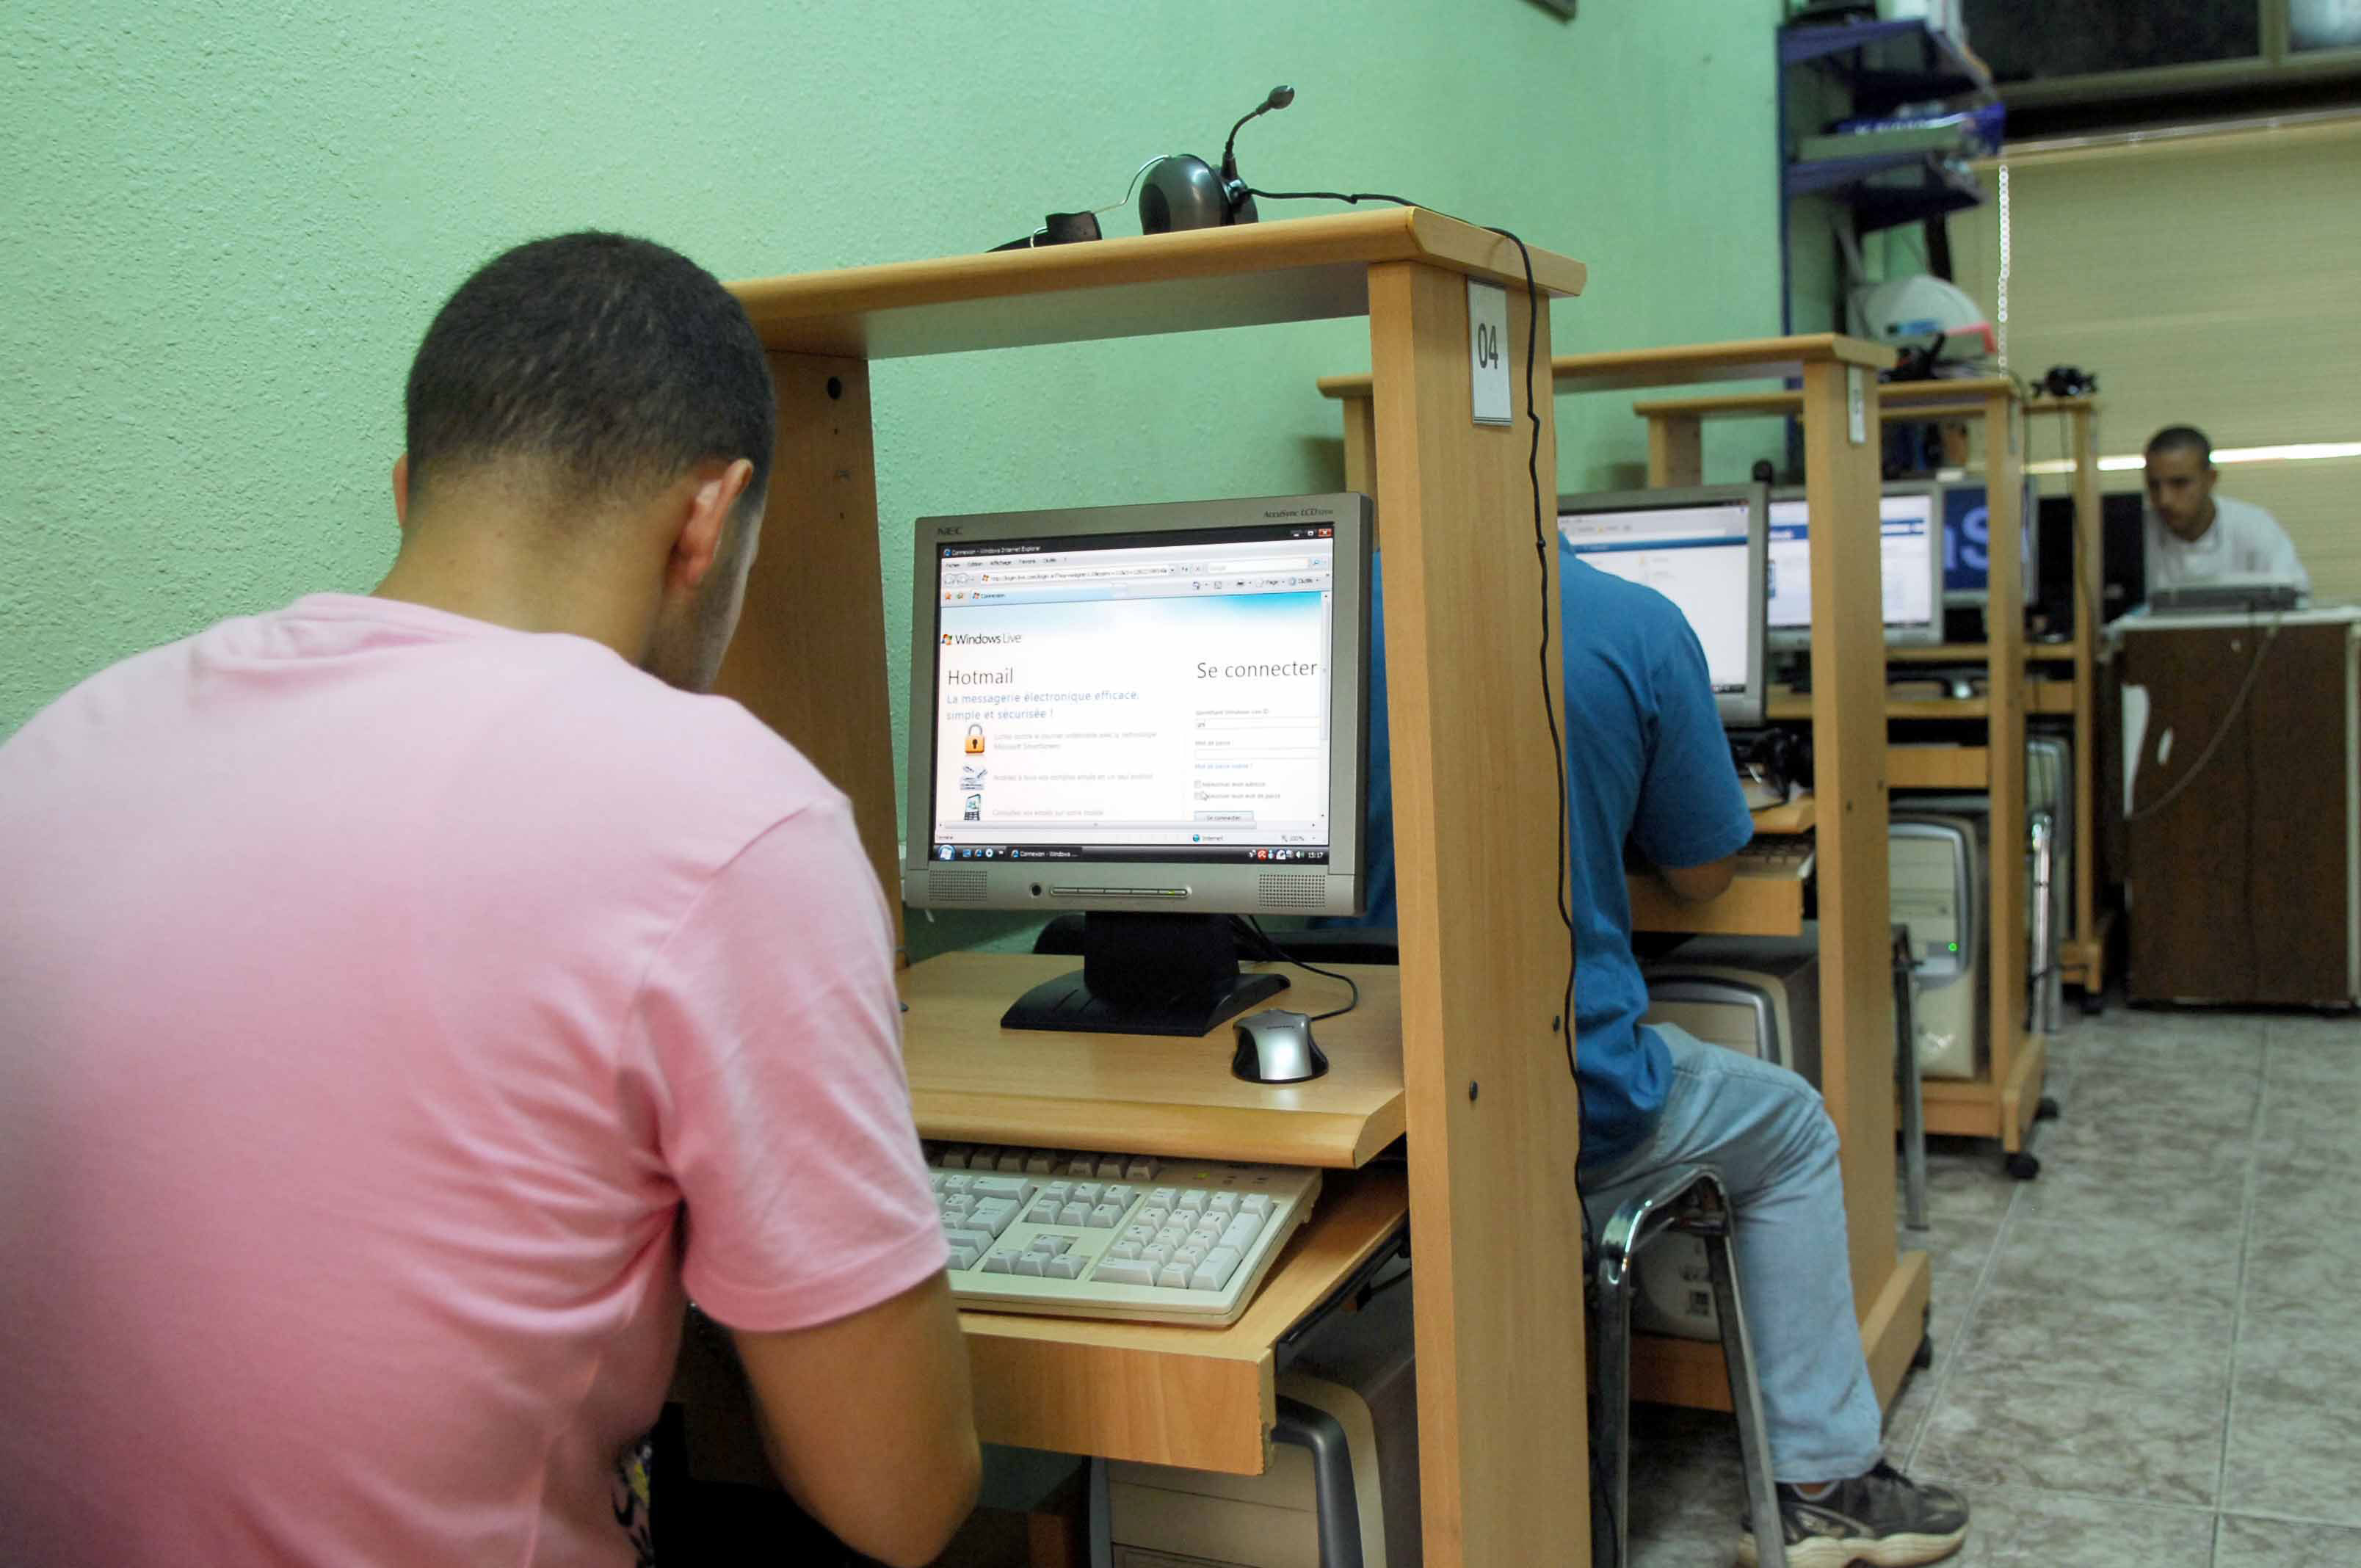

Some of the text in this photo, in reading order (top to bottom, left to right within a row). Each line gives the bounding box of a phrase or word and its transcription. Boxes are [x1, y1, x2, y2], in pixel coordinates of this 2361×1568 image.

[1478, 322, 1498, 370] 04
[937, 527, 963, 536] NEC
[955, 633, 1022, 645] Windows Live
[948, 667, 1014, 685] Hotmail
[1197, 661, 1318, 678] Se connecter
[946, 694, 958, 704] La
[962, 693, 1021, 705] messagerie
[946, 709, 981, 722] simple
[984, 710, 994, 719] et
